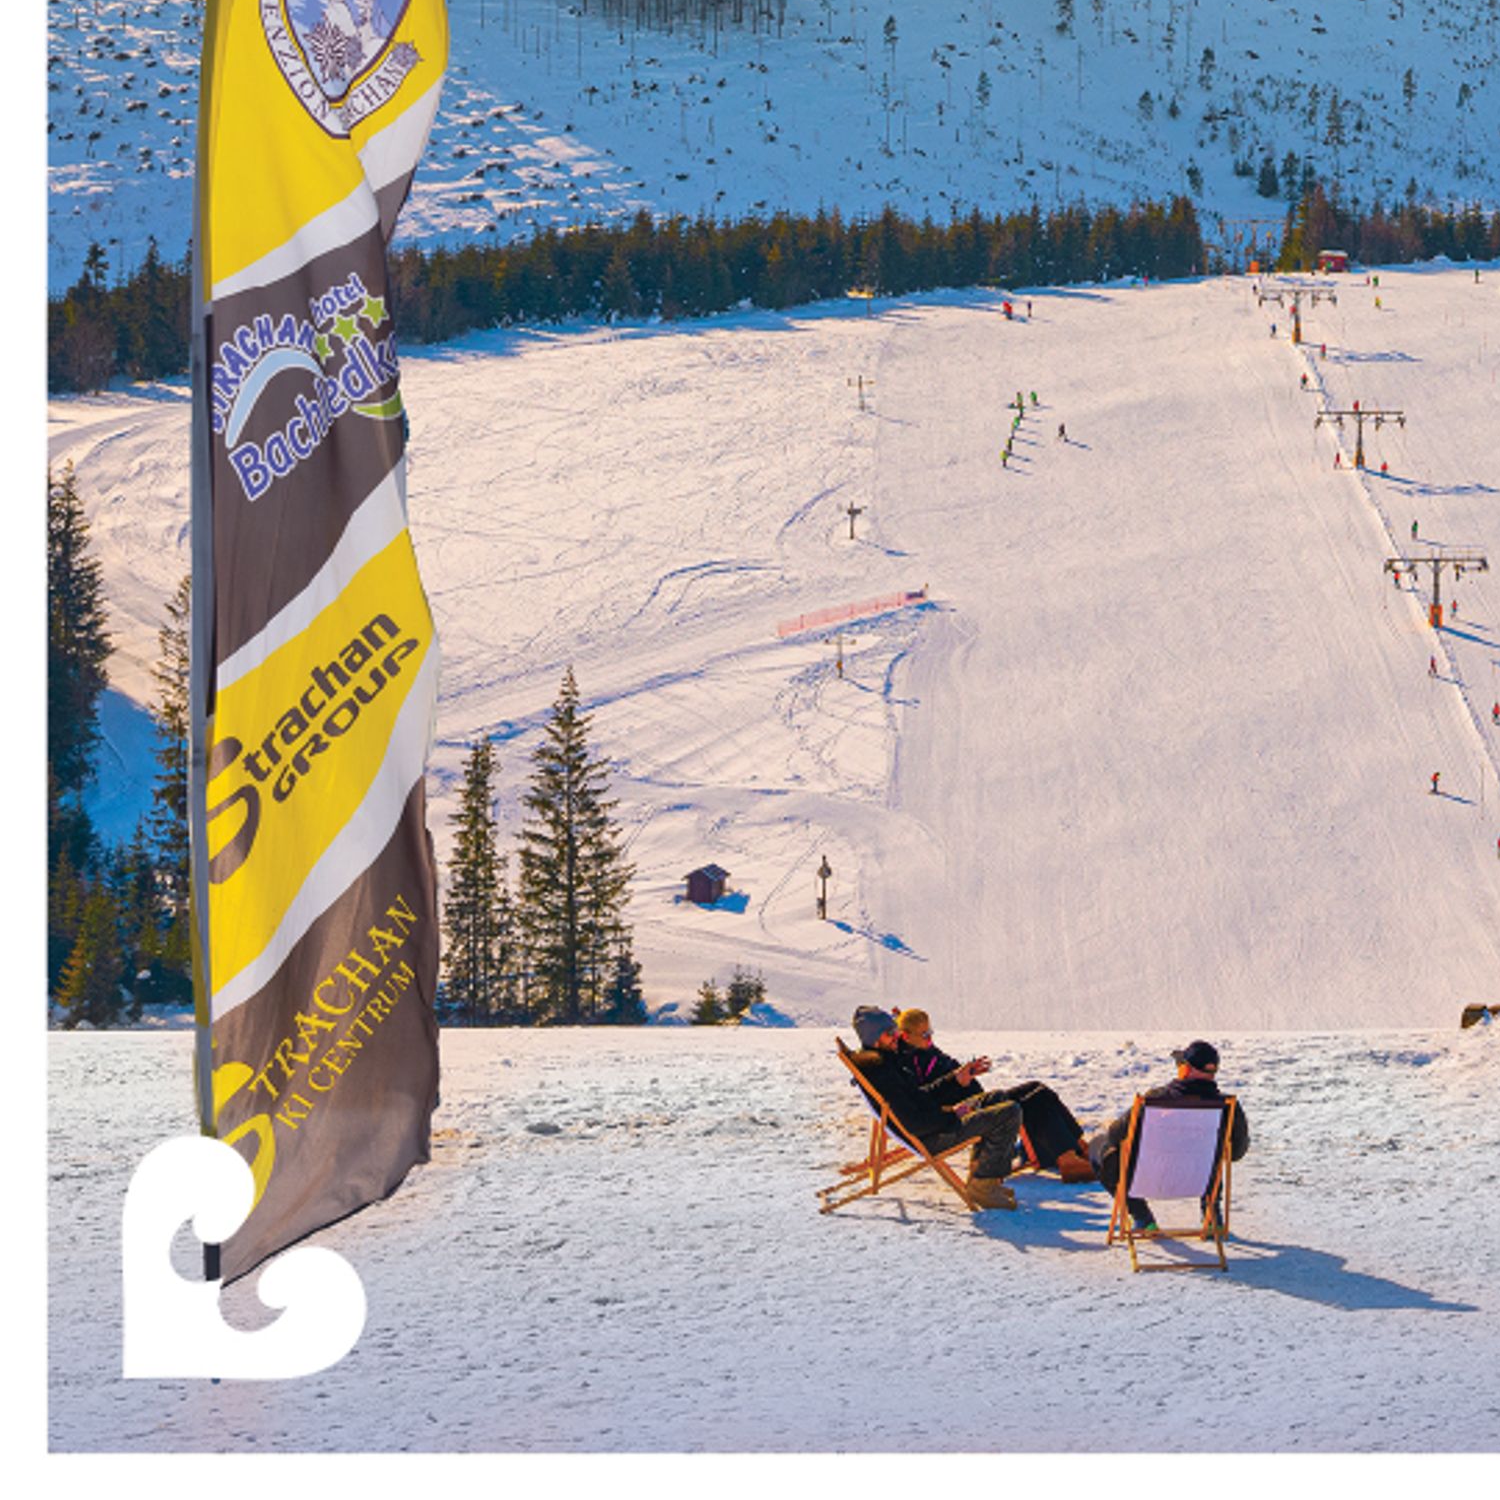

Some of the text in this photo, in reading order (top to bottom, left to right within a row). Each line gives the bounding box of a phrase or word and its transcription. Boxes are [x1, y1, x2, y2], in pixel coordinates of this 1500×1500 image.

[309, 271, 367, 328] hotel
[207, 613, 401, 885] Strachan
[272, 638, 420, 803] GROUP
[308, 960, 417, 1094] CENTRUM
